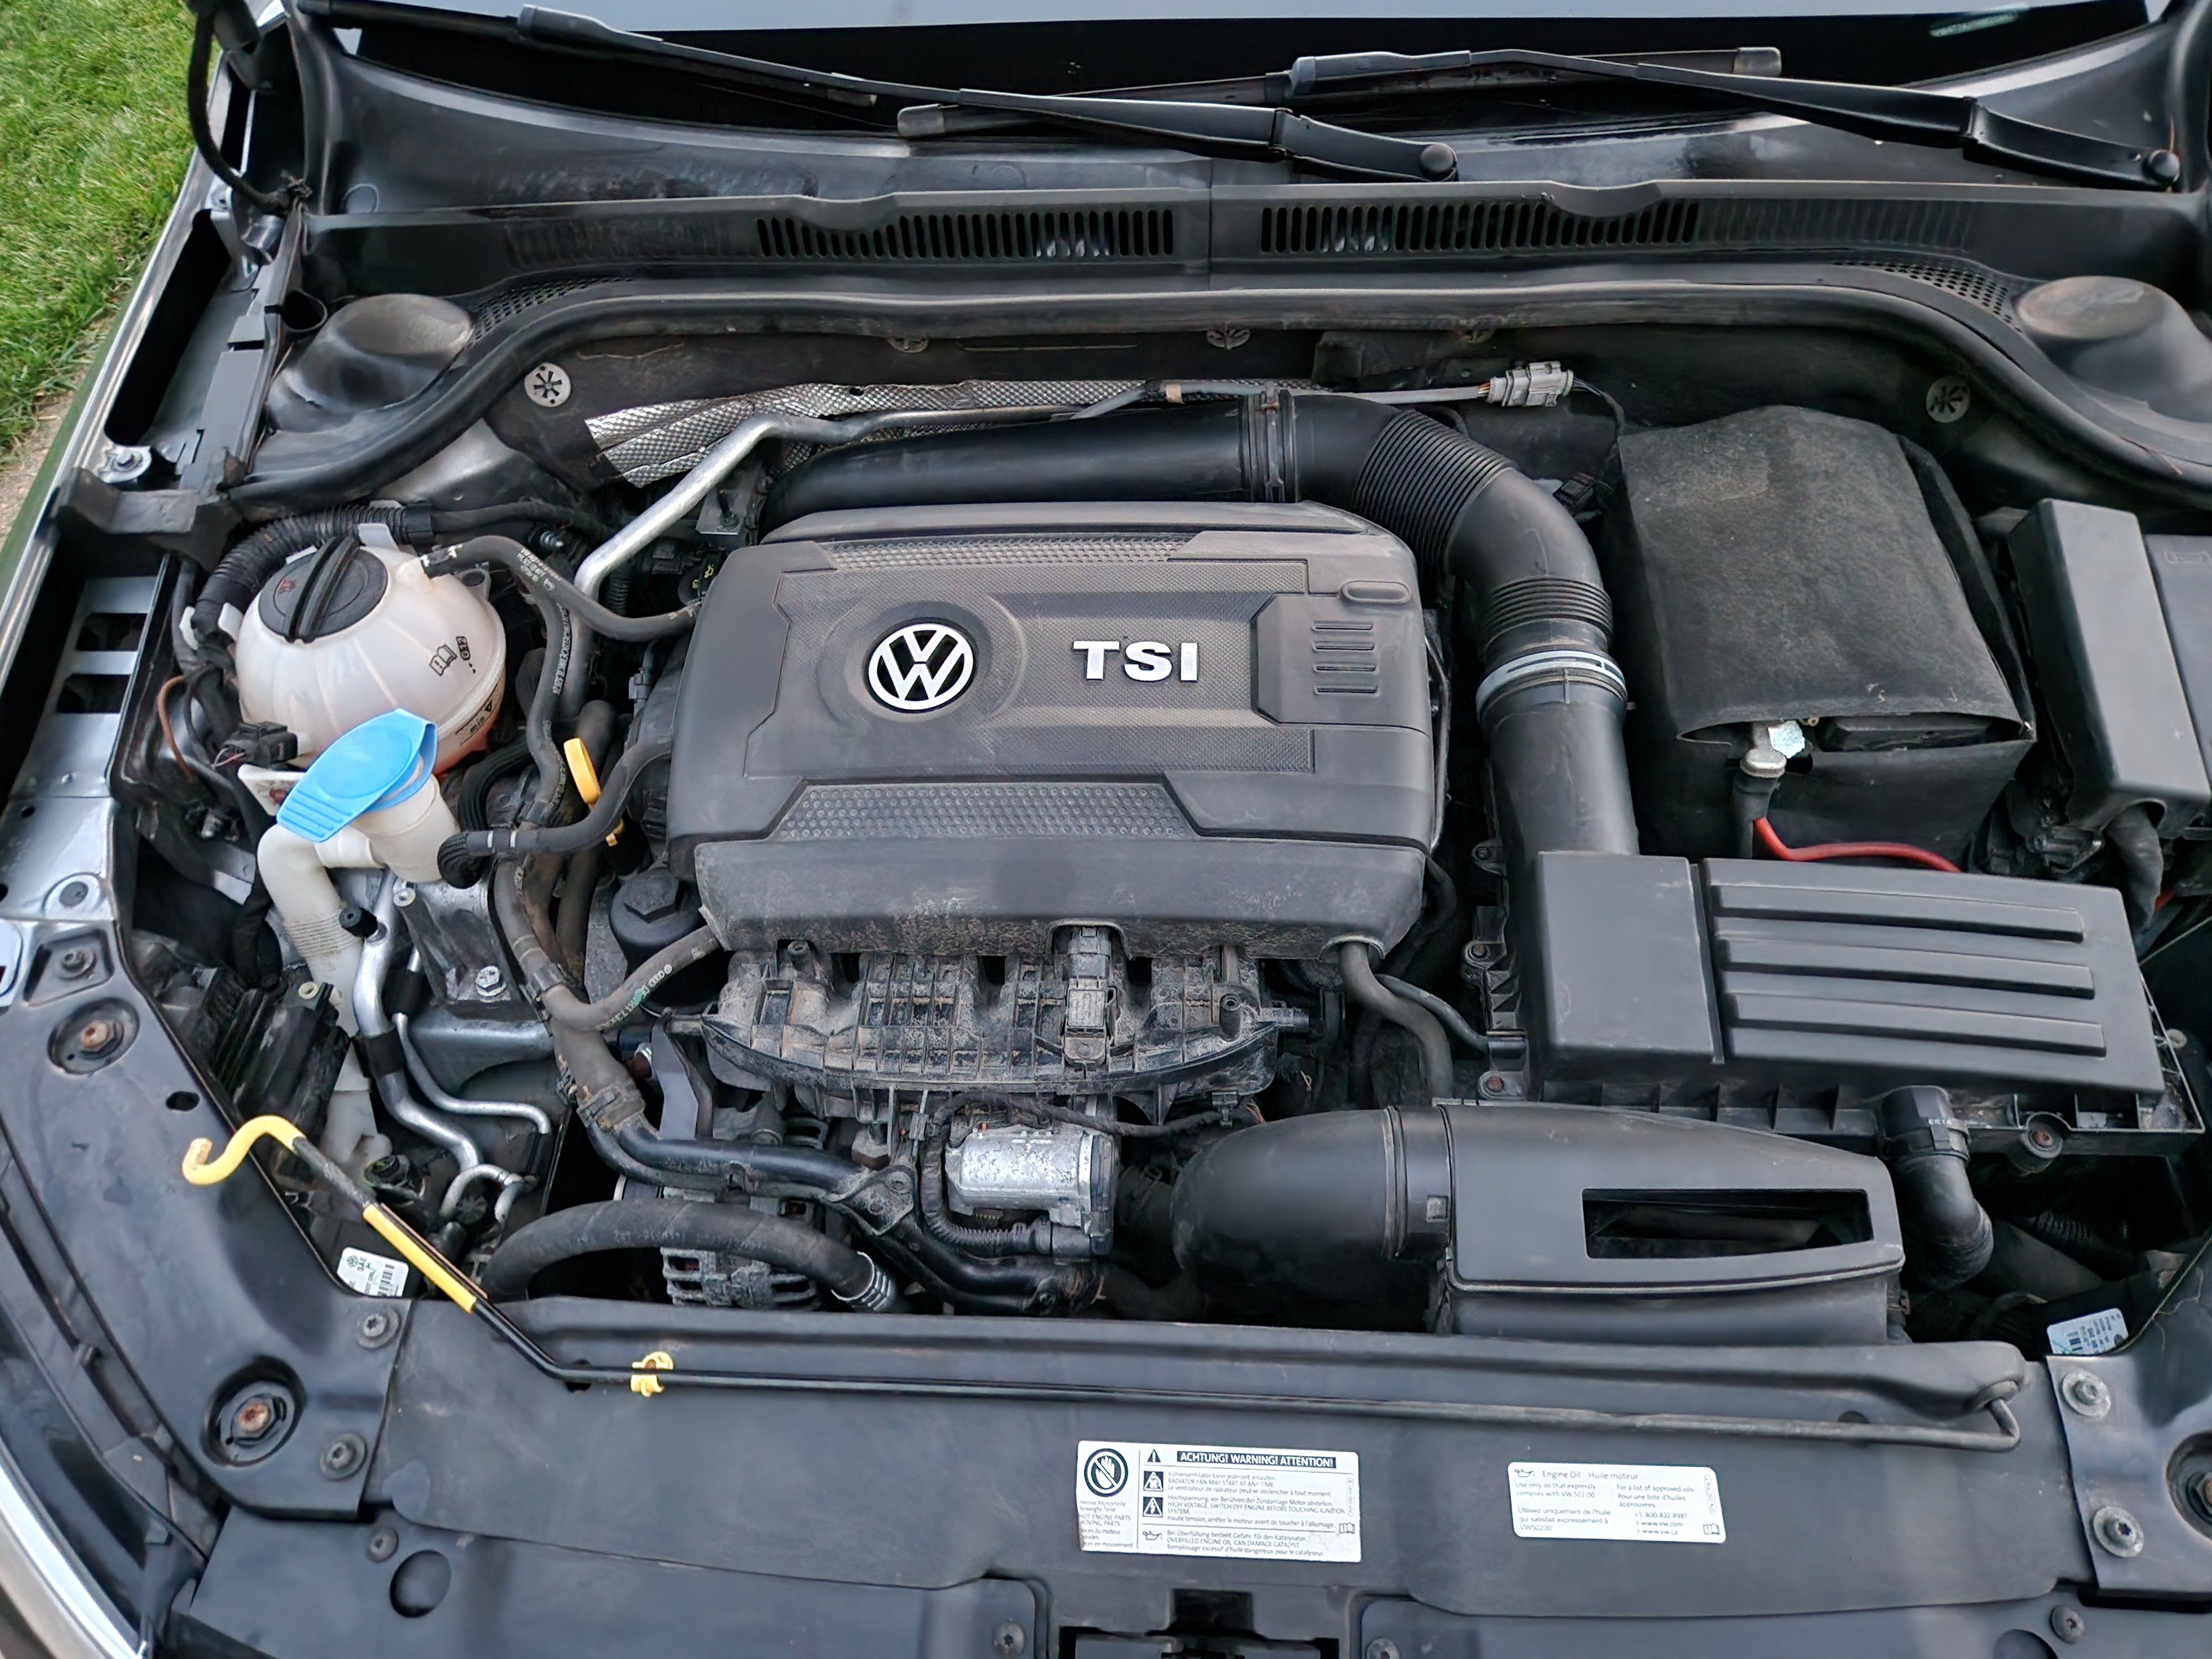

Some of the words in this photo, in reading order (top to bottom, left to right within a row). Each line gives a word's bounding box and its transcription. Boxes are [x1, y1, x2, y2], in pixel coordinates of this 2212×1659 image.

[1073, 640, 1198, 682] TSI
[1181, 1452, 1228, 1463] ACHTUNG!
[1230, 1453, 1277, 1465] WARNING!
[1280, 1457, 1333, 1468] ATTENTION!
[1543, 1470, 1568, 1479] Engine
[1256, 1498, 1287, 1506] Zündanlage
[1177, 1530, 1209, 1538] Überfüllung
[1167, 1544, 1201, 1553] Remplissage
